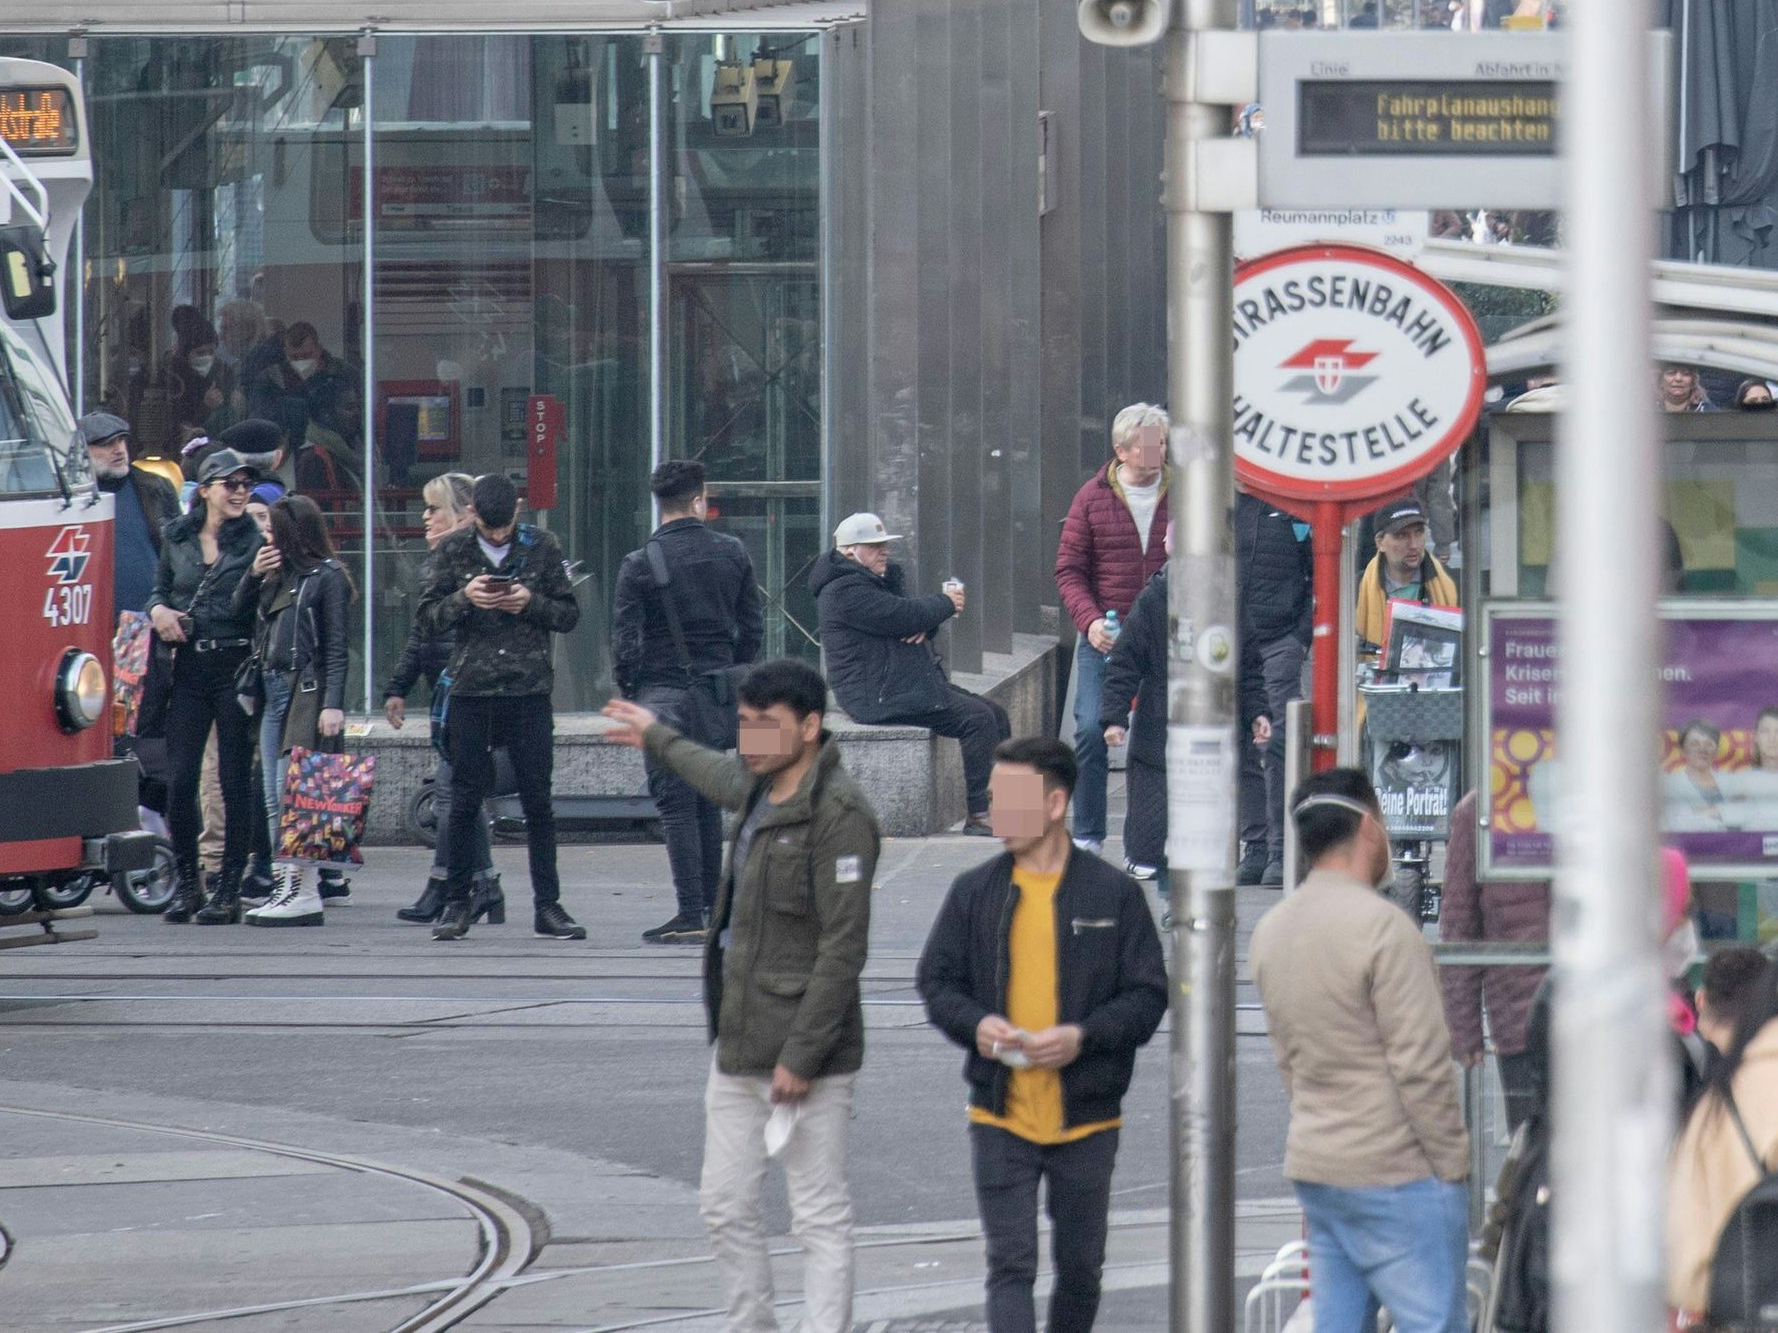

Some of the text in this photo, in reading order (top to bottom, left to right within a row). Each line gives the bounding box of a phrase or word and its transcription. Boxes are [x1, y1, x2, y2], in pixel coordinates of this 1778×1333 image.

[1310, 61, 1349, 76] Linie
[1474, 62, 1535, 76] Abfahrt
[1377, 120, 1550, 141] bitte beachten
[1260, 209, 1378, 226] Reumannplatz
[1383, 233, 1413, 246] 2243
[536, 400, 546, 444] STOP
[43, 584, 92, 627] 4307
[1505, 689, 1541, 705] Seit
[1406, 786, 1448, 816] Porträt!
